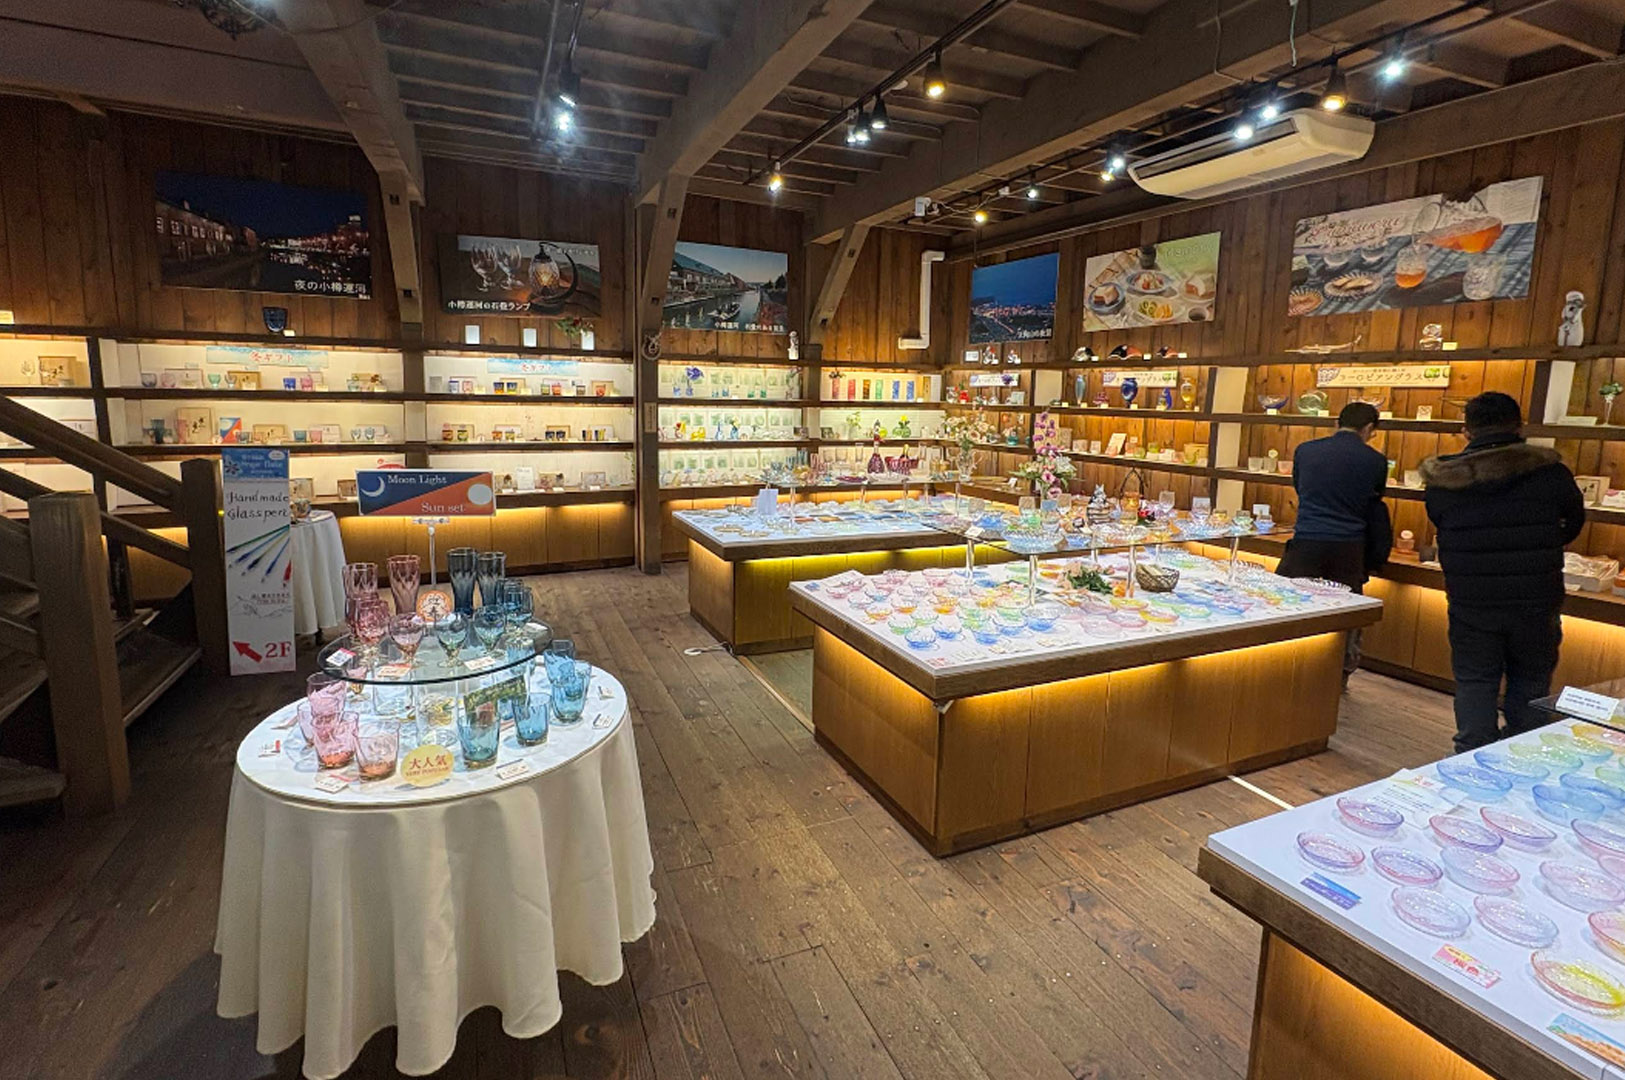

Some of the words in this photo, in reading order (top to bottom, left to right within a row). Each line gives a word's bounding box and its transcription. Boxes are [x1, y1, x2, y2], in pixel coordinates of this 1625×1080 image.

[294, 279, 367, 294] 夜の小樽運河
[387, 474, 416, 484] Moon
[419, 474, 448, 486] Light
[227, 505, 262, 521] Glass
[421, 502, 445, 513] Sun
[265, 641, 292, 659] 2F
[409, 754, 448, 770] 大人気
